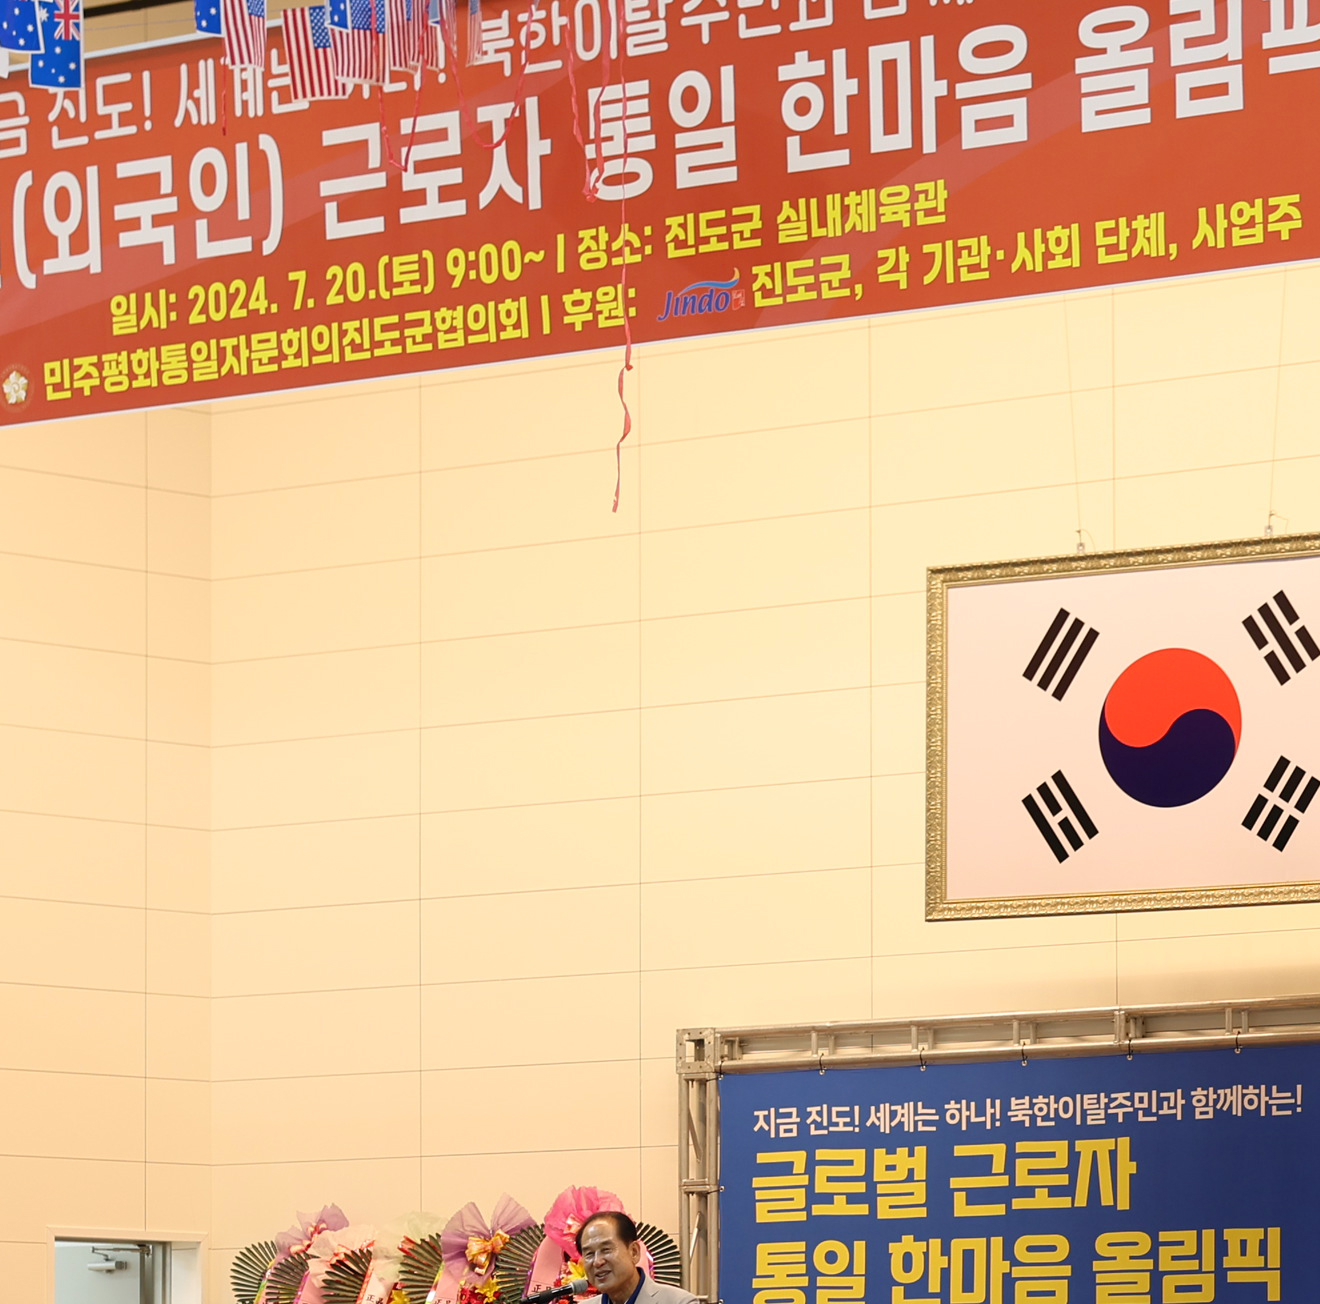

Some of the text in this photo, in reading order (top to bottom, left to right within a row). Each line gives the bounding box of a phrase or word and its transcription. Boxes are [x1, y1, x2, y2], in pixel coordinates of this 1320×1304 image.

[47, 72, 153, 149] 진도!
[320, 95, 551, 241] 근로자
[586, 64, 739, 201] 통일
[777, 24, 1033, 174] 한마음
[110, 179, 948, 336] 일시: 2024. 7. 20.(토) 9:00~ 장소: 진도군 실내체육관
[752, 255, 863, 309] 진도군,
[877, 247, 910, 291] 각
[1095, 211, 1178, 266] 단체,
[1191, 194, 1303, 251] 사업주
[43, 297, 530, 402] 민주평화통일자문회의진도군협의회
[563, 285, 637, 332] 후원:
[753, 1084, 1303, 1138] 지금 진도! 세계는 하나! 북한이탈주민과 함께하는!
[751, 1136, 1137, 1223] 글로벌 근로자
